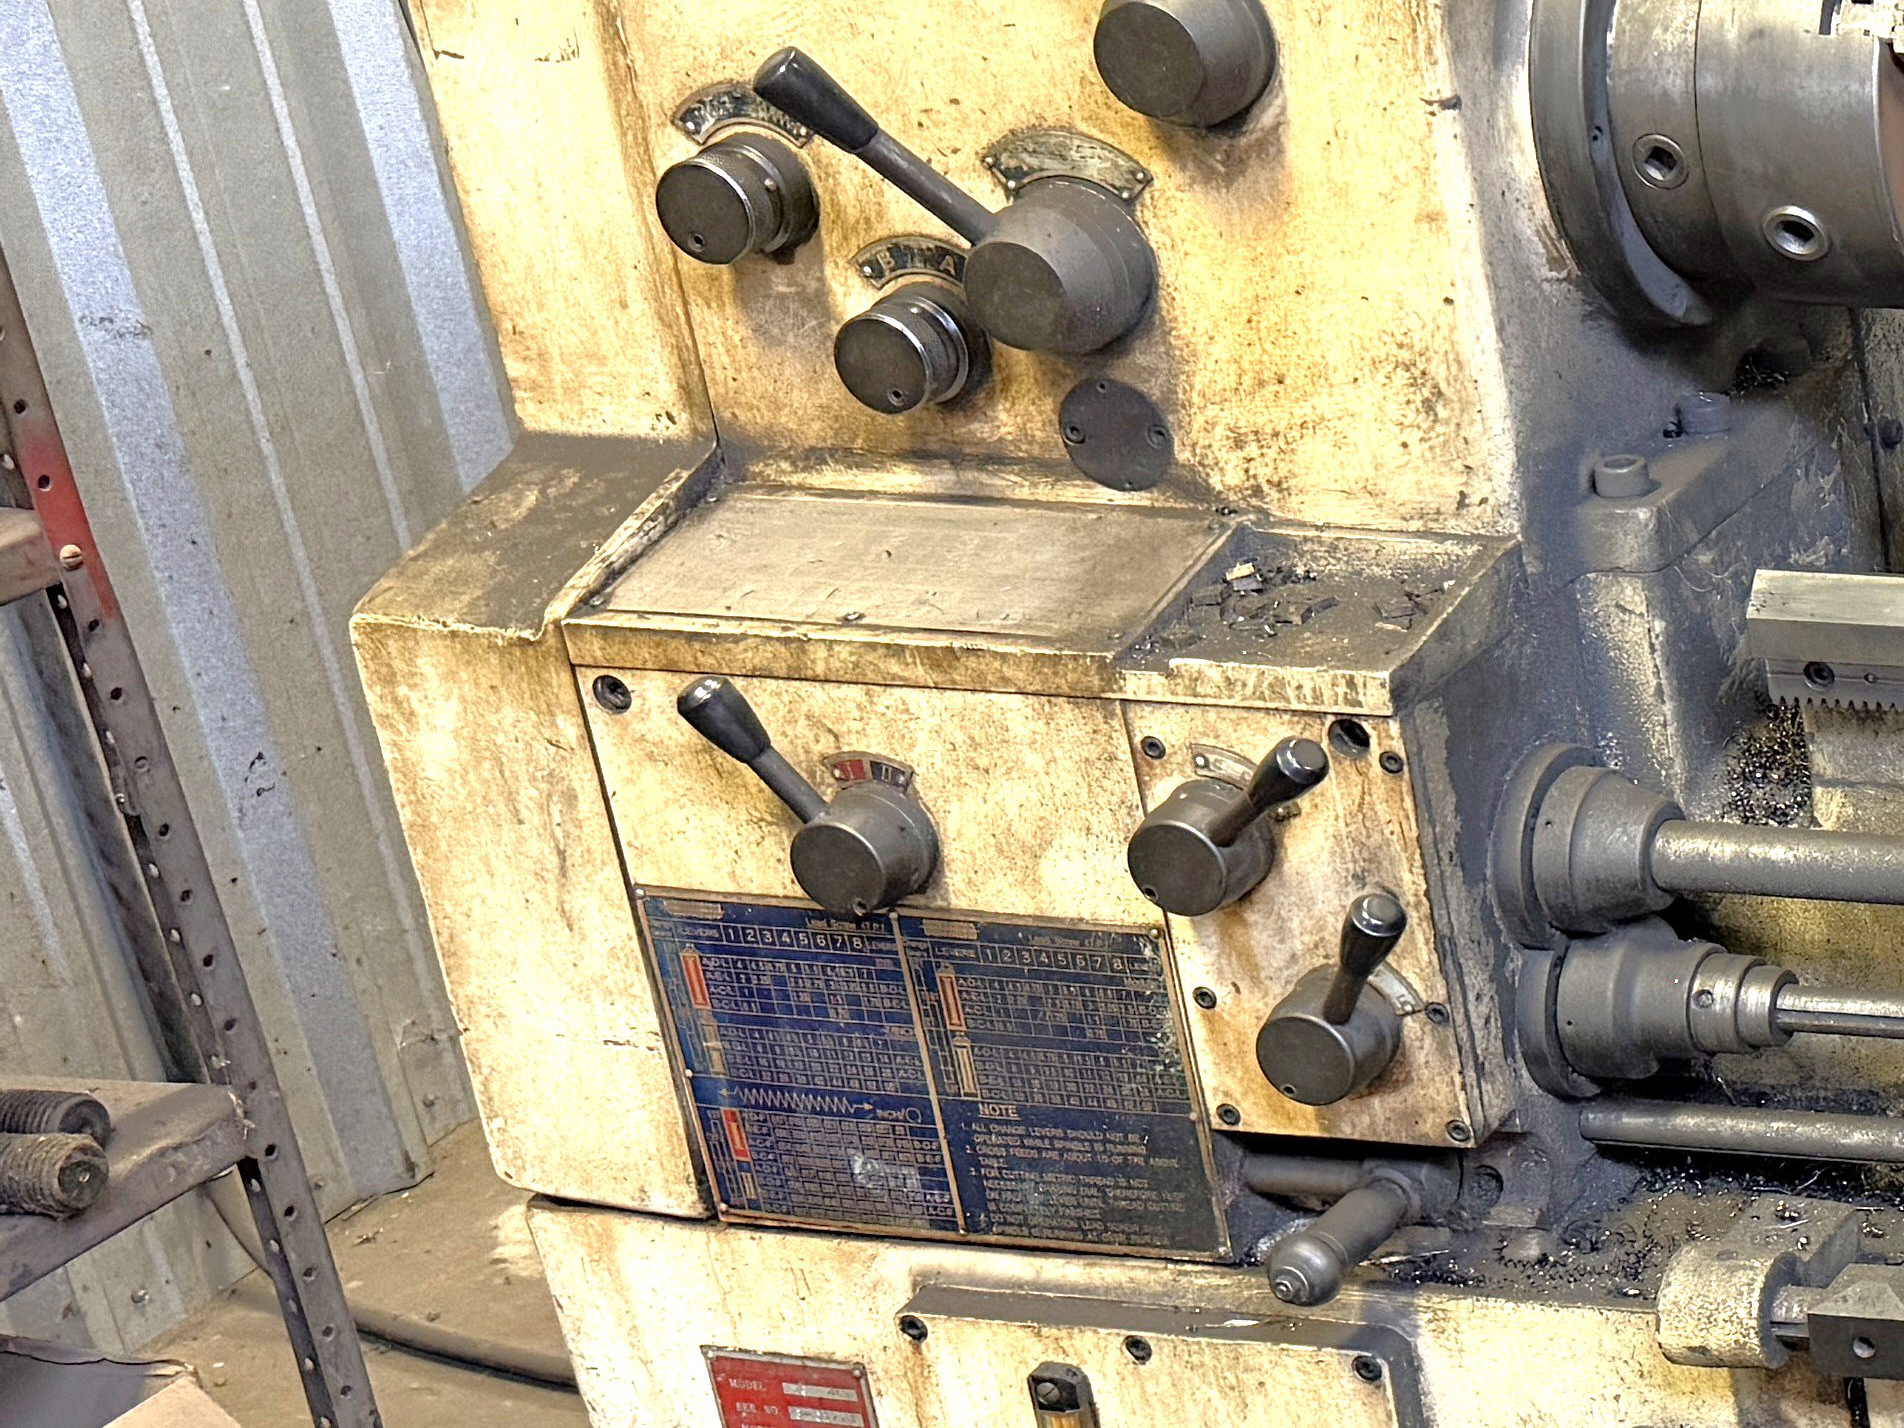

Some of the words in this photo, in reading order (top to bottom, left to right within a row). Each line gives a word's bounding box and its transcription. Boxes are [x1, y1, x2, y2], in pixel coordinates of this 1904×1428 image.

[877, 250, 895, 270] B
[939, 255, 956, 276] A
[727, 928, 735, 939] 1
[744, 929, 756, 941] 2
[760, 931, 773, 943] 3
[779, 932, 792, 944] 4
[797, 934, 809, 945] 5
[815, 935, 828, 947] 6
[832, 936, 844, 948] 7
[850, 938, 863, 950] 8
[984, 948, 993, 960] 1
[1001, 949, 1013, 961] 2
[1019, 950, 1032, 963] 3
[1037, 951, 1050, 964] 4
[1055, 952, 1068, 965] 5
[1074, 954, 1087, 967] 6
[1092, 956, 1103, 968] 7
[1110, 957, 1123, 970] 8
[978, 1103, 1018, 1118] NOTE
[969, 1120, 989, 1132] ALL
[979, 1165, 1001, 1178] FOR
[729, 1378, 767, 1391] MODEL
